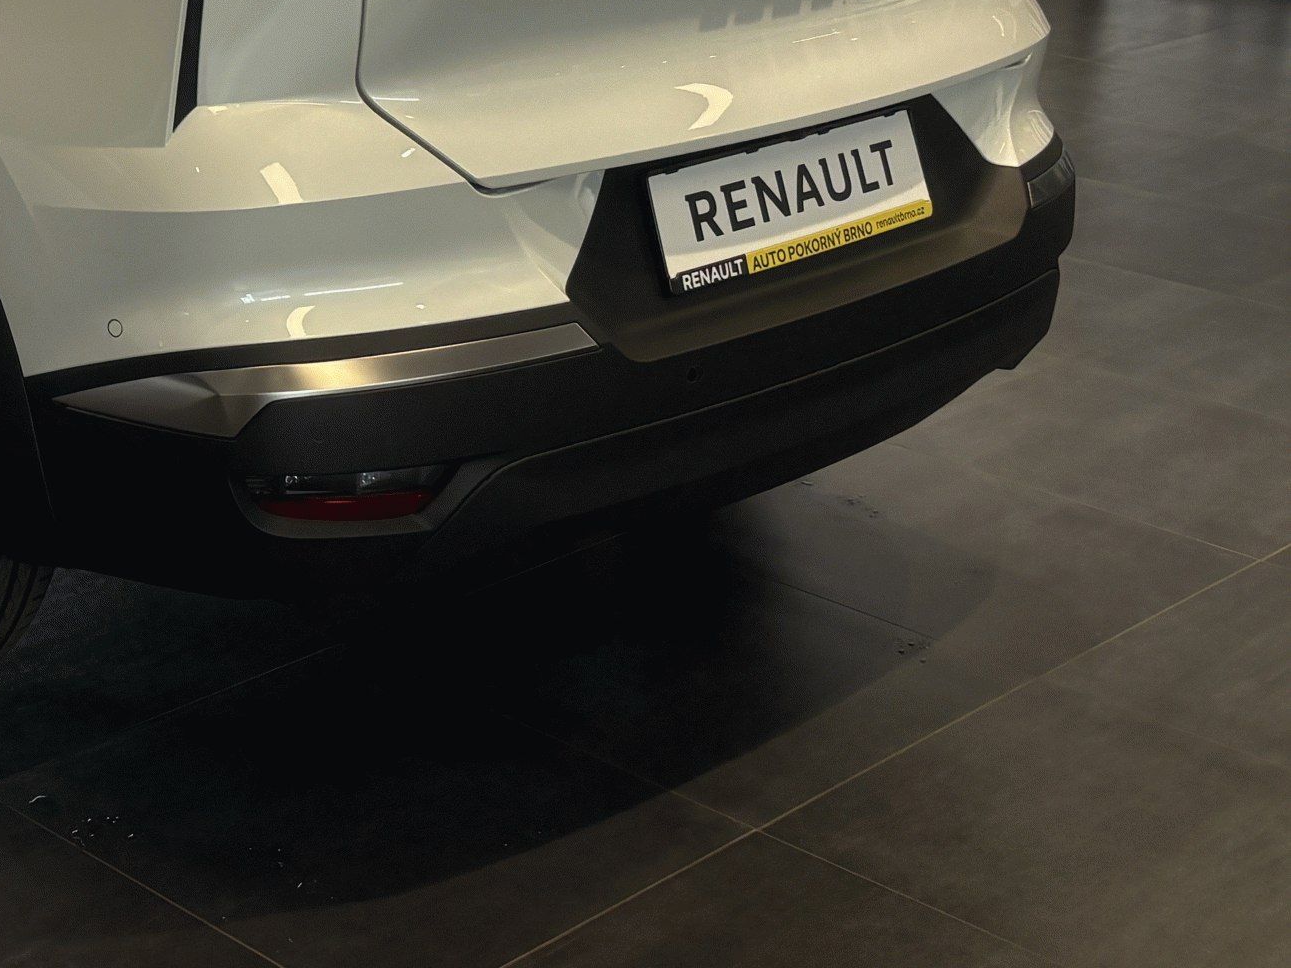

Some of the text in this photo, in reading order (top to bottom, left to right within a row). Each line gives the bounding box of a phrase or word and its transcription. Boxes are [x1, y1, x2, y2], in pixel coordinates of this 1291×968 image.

[684, 139, 893, 242] RENAULT
[681, 206, 926, 291] RENAULT AUTO POKORNÝ BRNO renaultbrno.cz
